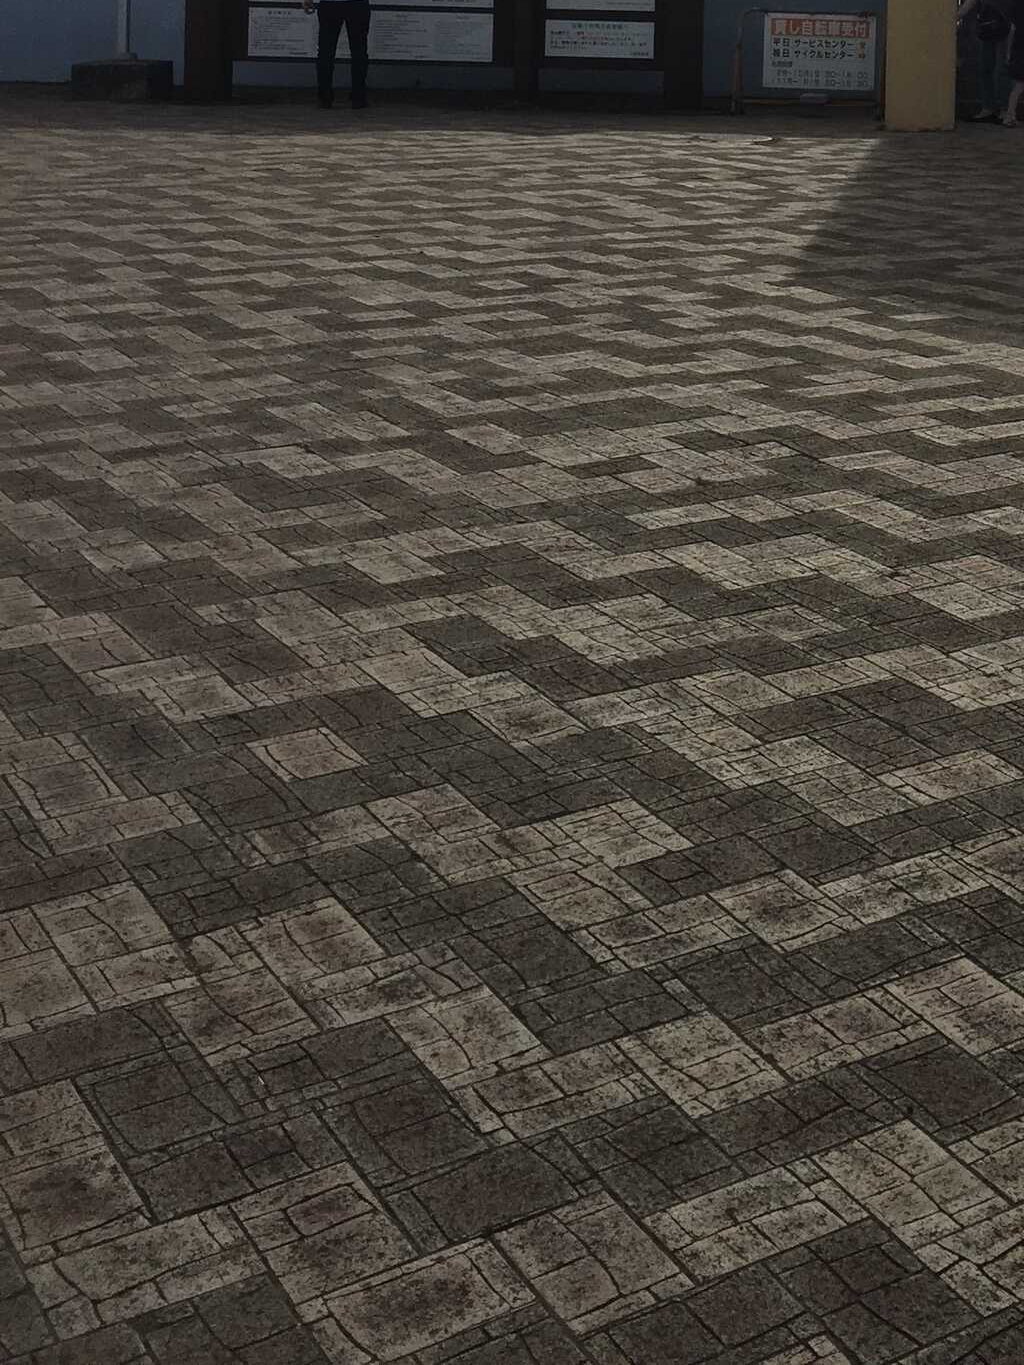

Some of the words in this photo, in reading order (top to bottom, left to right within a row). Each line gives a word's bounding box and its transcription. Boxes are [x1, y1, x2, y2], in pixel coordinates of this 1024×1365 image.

[794, 38, 855, 48] サービスセンター
[794, 49, 855, 59] サイクルセンター
